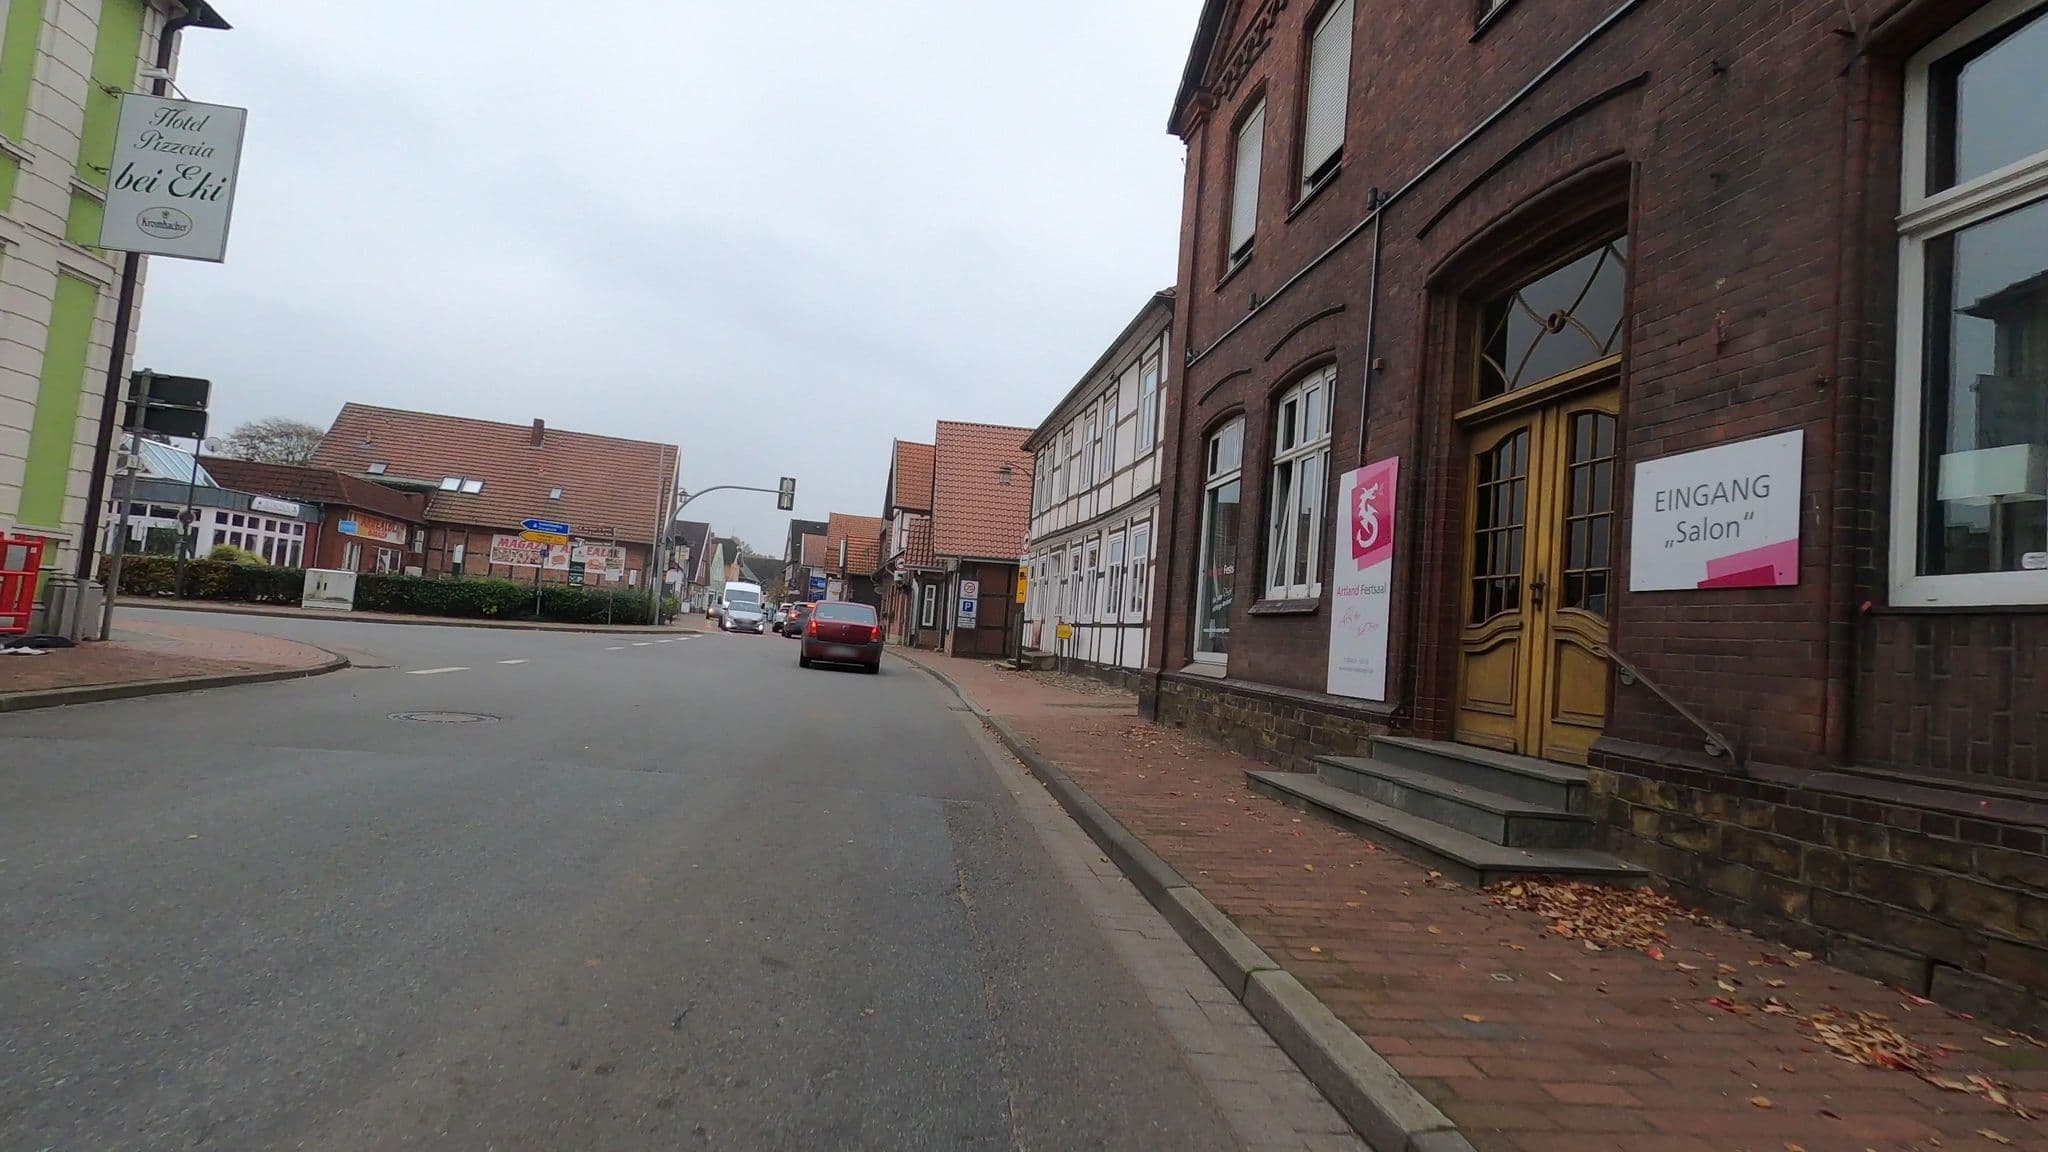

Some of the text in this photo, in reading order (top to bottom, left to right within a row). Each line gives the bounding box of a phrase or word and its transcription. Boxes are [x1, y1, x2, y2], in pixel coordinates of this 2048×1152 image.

[148, 107, 210, 133] Hotel
[134, 129, 216, 159] Pizzeria
[114, 162, 228, 202] bei Eki
[141, 218, 188, 232] Krombacher
[1655, 474, 1771, 512] EINGANG
[1336, 585, 1360, 597] Artland
